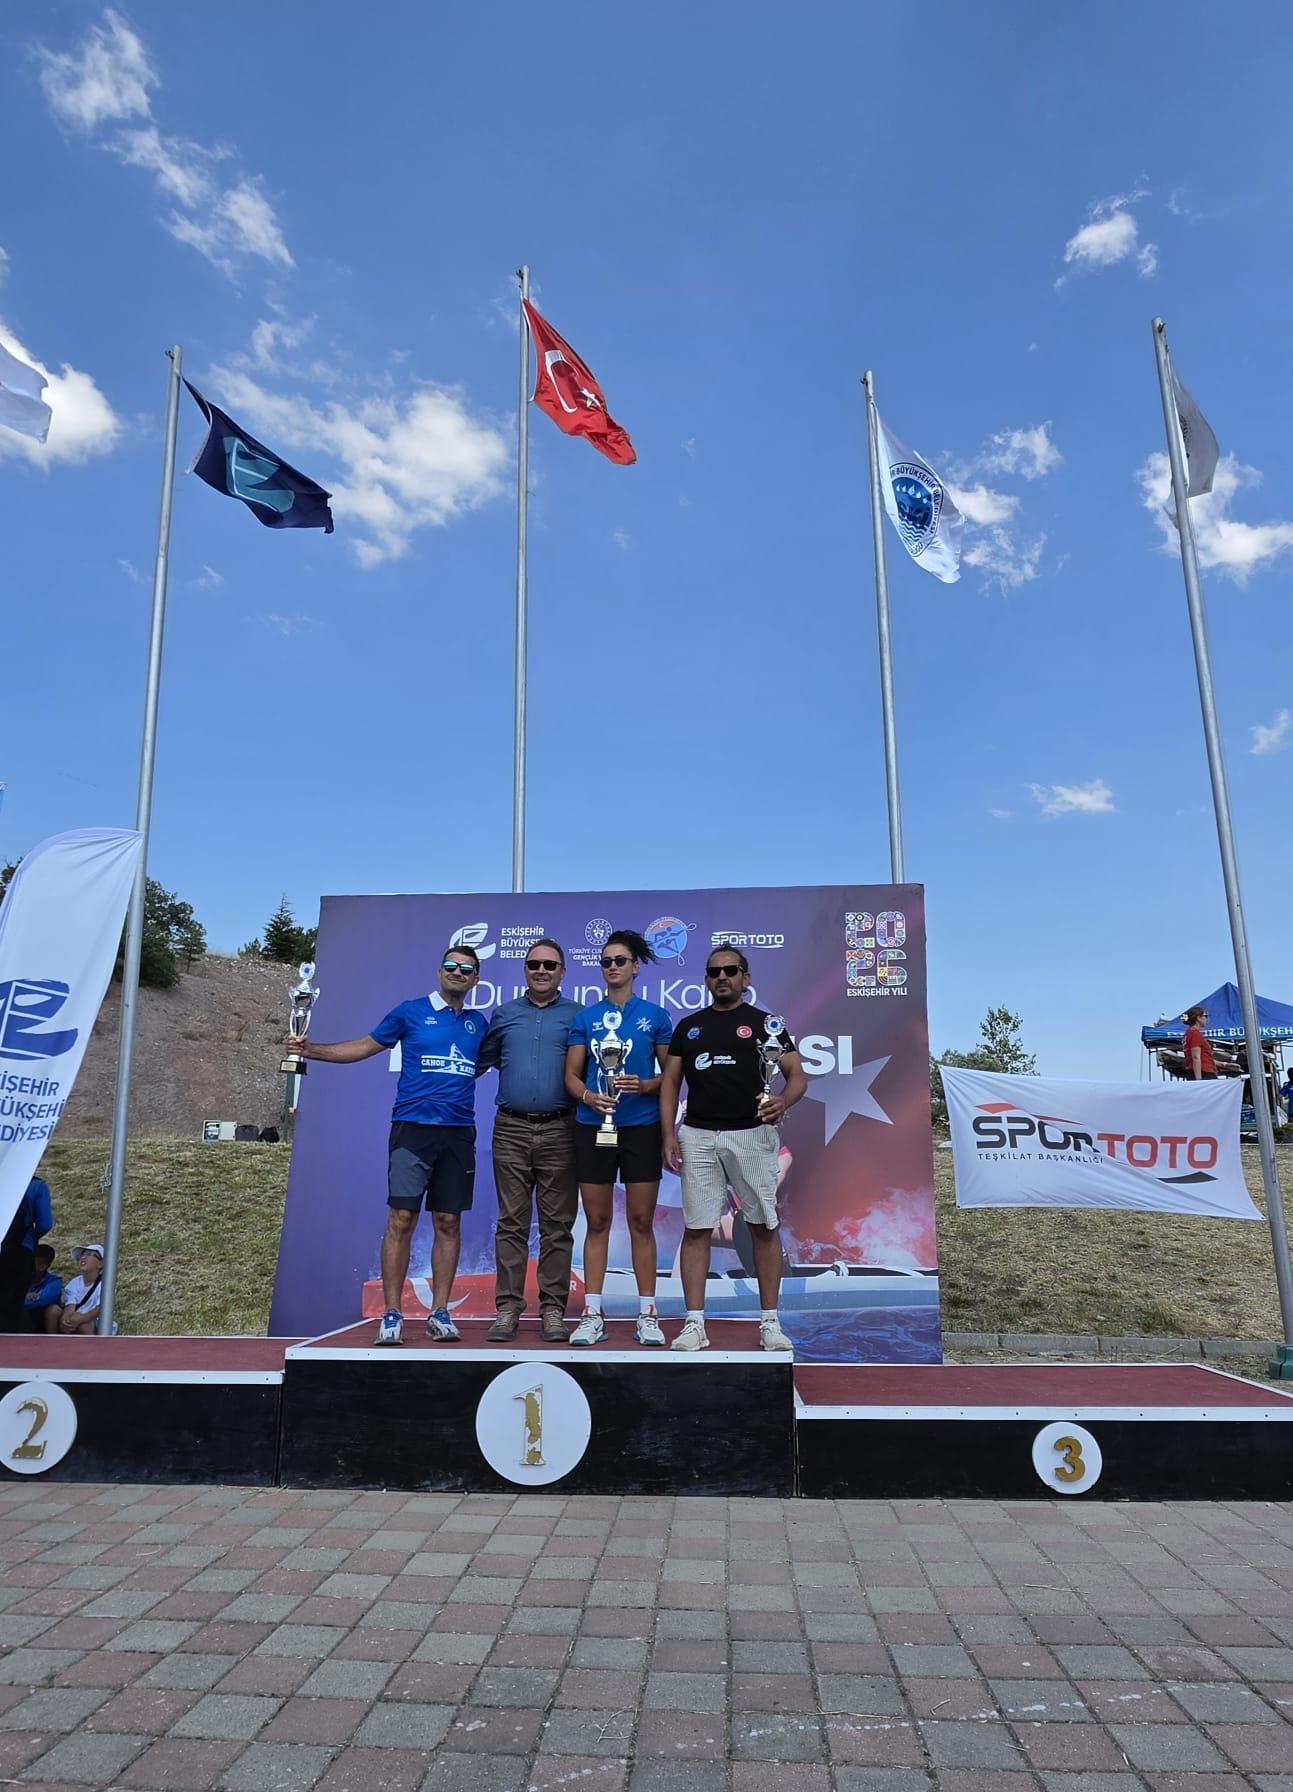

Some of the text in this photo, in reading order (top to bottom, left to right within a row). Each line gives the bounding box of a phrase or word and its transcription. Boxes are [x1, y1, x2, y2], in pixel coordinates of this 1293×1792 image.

[501, 925, 545, 936] ESKİŞEHİR
[711, 933, 784, 946] SPORTOTO
[499, 949, 529, 959] BELED
[660, 979, 757, 1009] Kao
[847, 986, 908, 997] ESKİŞEHİR YILI
[0, 1070, 60, 1097] İŞEHİR
[0, 1095, 65, 1122] ÜKŞEHİ
[0, 1121, 55, 1143] DİYESİ
[977, 1152, 1032, 1161] TEŞKİLAT
[15, 1396, 49, 1459] 2
[512, 1383, 547, 1466] 1
[1052, 1436, 1087, 1482] 3
